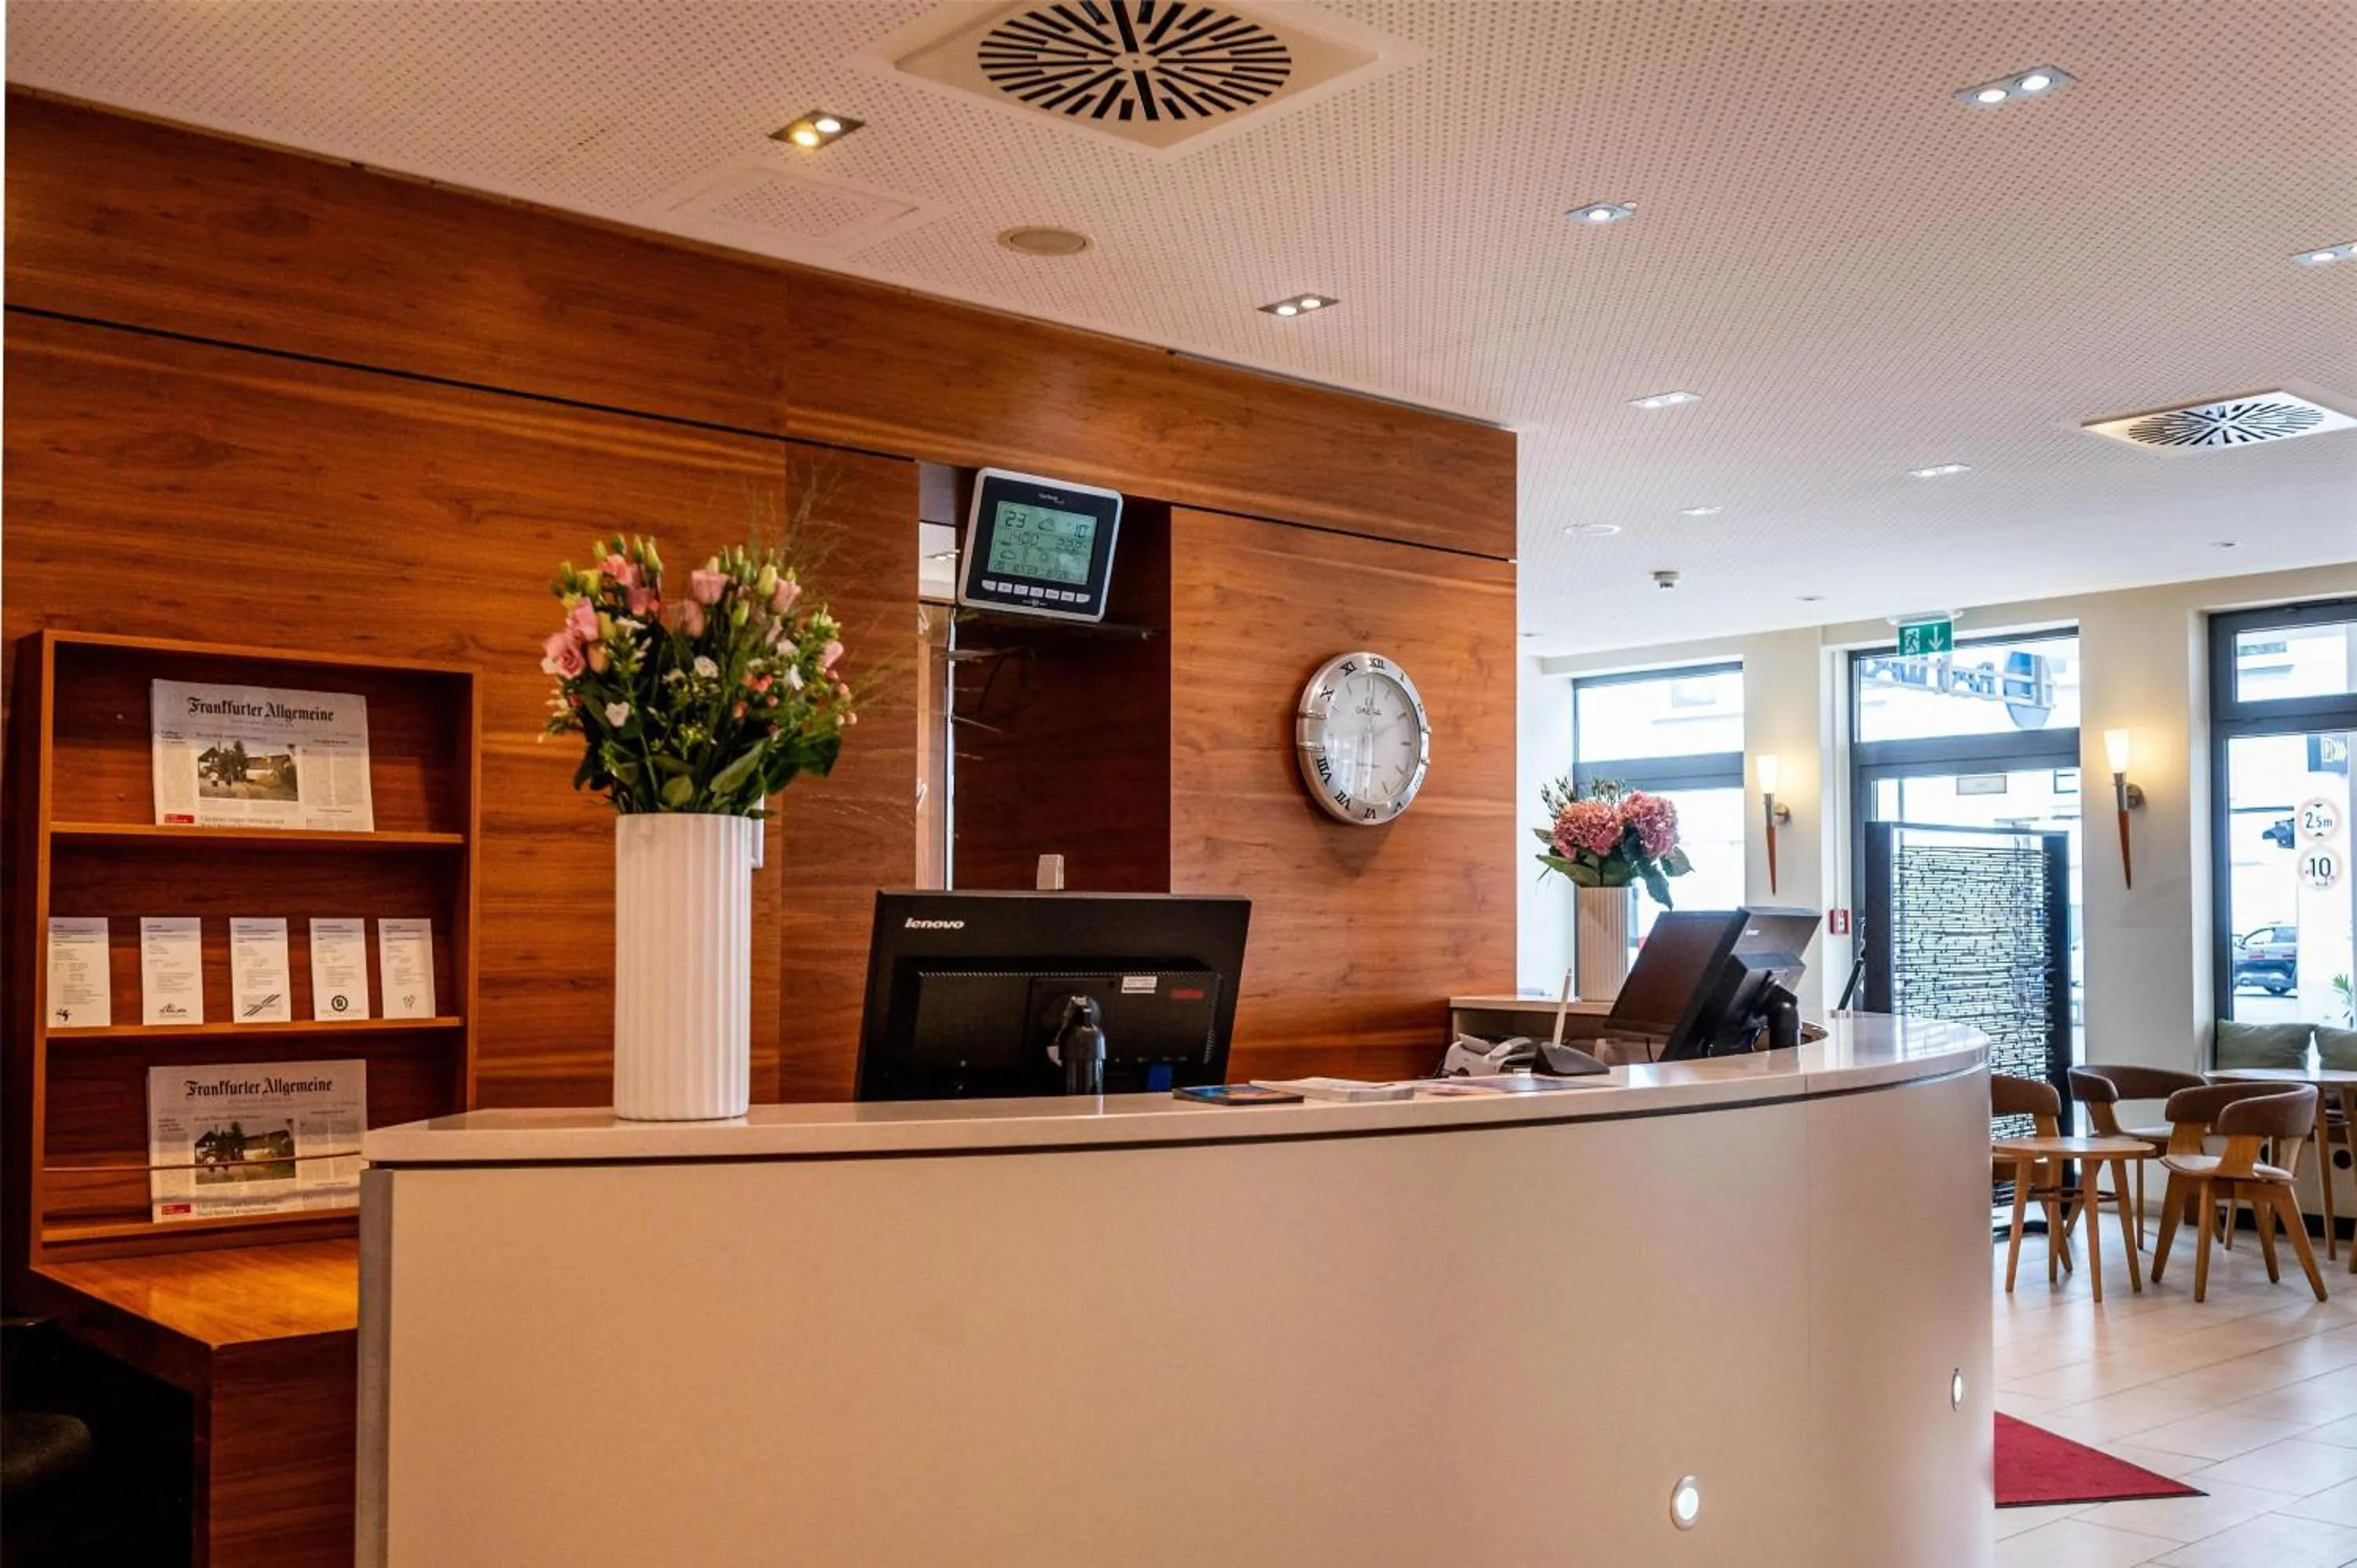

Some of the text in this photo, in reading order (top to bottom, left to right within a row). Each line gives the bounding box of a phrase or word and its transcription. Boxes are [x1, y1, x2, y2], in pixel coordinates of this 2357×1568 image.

[1005, 511, 1028, 529] 23
[1340, 661, 1358, 676] XI
[1369, 658, 1384, 669] XII
[1319, 684, 1335, 702] X
[187, 696, 335, 723] Frankfurter Allgemeine
[1333, 789, 1351, 811] VII
[904, 917, 966, 929] lenovo
[184, 1076, 333, 1097] Frankfurter Allgemeine
